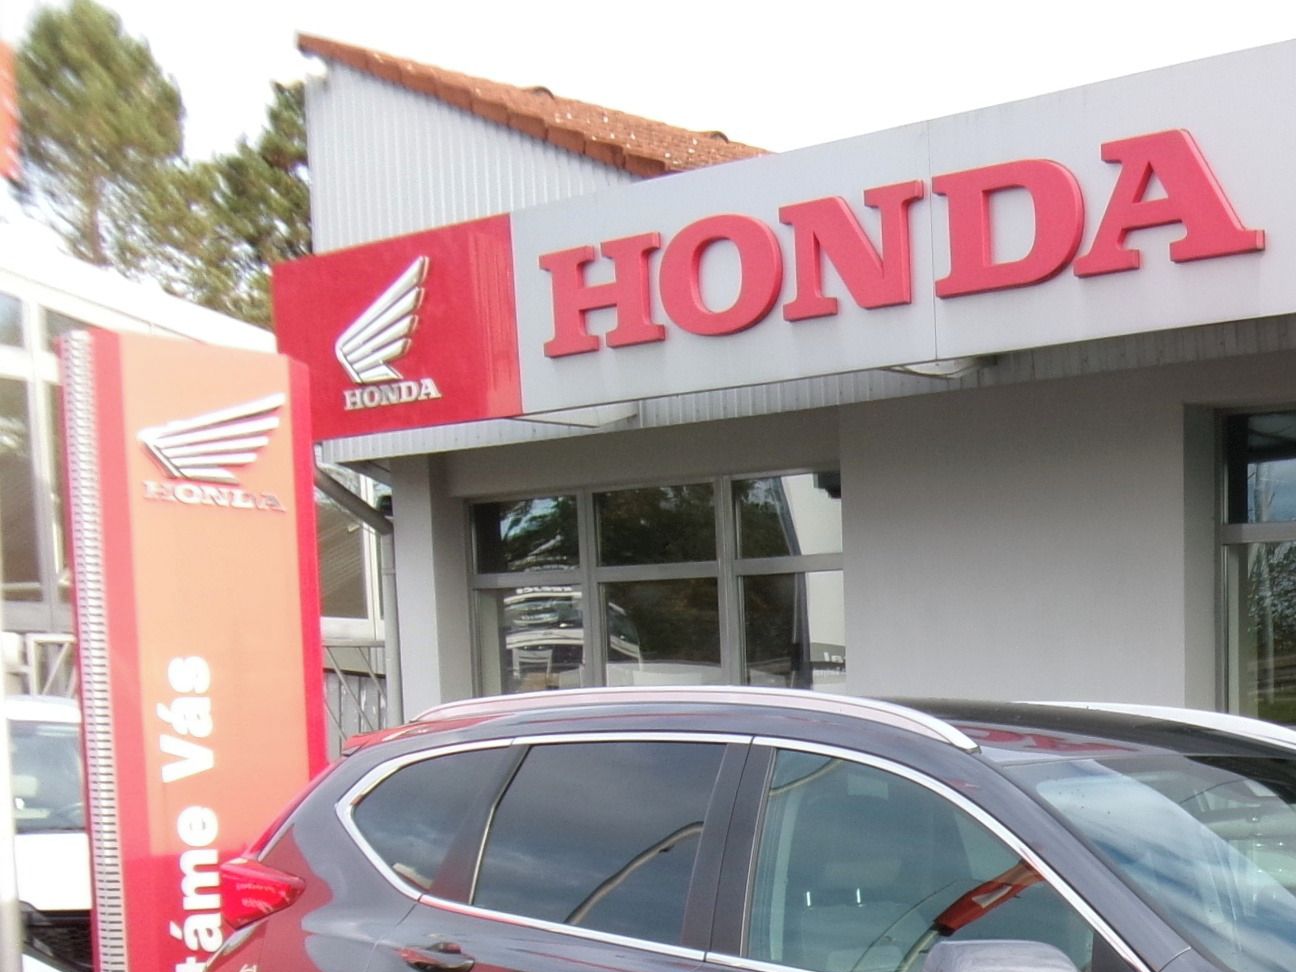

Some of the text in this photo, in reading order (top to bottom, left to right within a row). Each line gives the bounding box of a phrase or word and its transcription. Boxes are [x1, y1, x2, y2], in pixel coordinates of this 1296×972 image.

[539, 128, 1265, 358] HONDA
[343, 378, 441, 410] HONDA
[144, 480, 286, 512] HONDA
[156, 655, 215, 783] Vás
